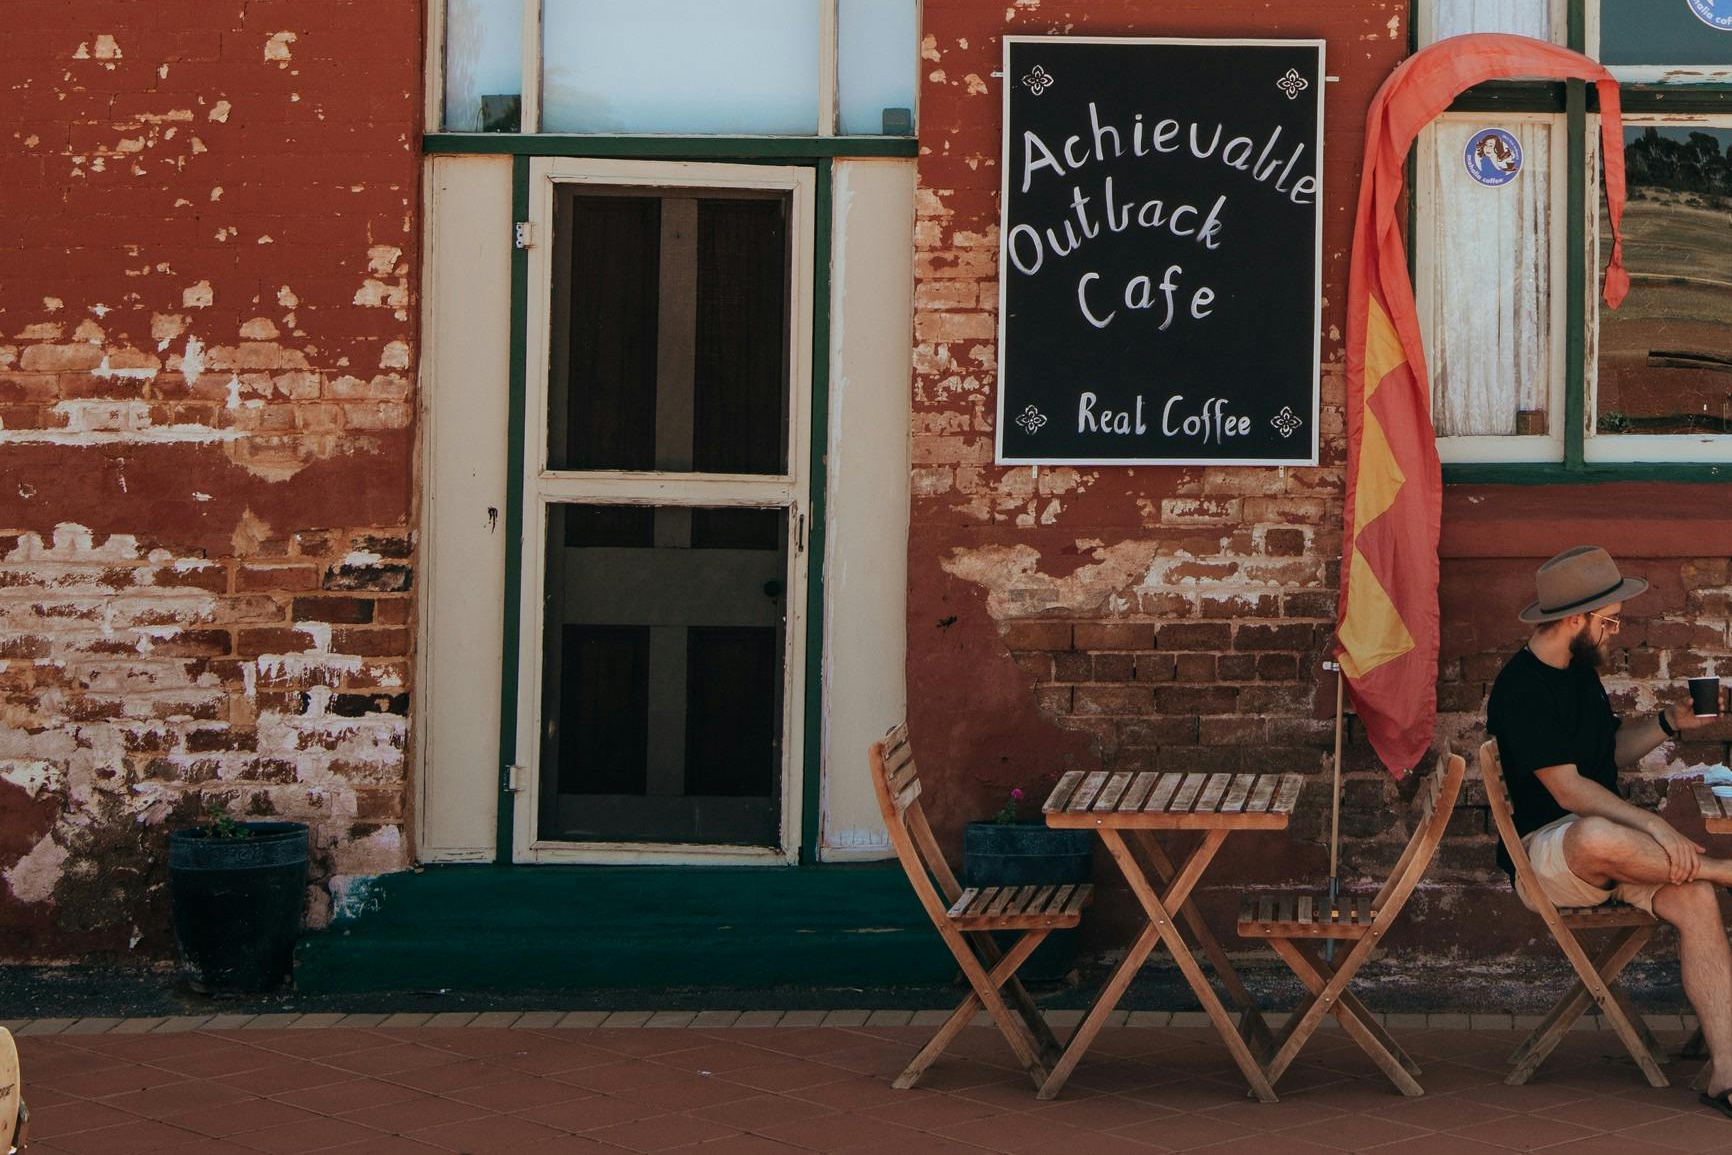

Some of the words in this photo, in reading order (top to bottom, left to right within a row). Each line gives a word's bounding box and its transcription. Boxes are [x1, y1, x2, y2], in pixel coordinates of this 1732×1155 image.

[1022, 101, 1317, 204] Achievable
[1008, 176, 1227, 276] Outback
[1077, 264, 1215, 331] Cafe
[1077, 391, 1146, 436] Real
[1162, 395, 1252, 445] Coffee
